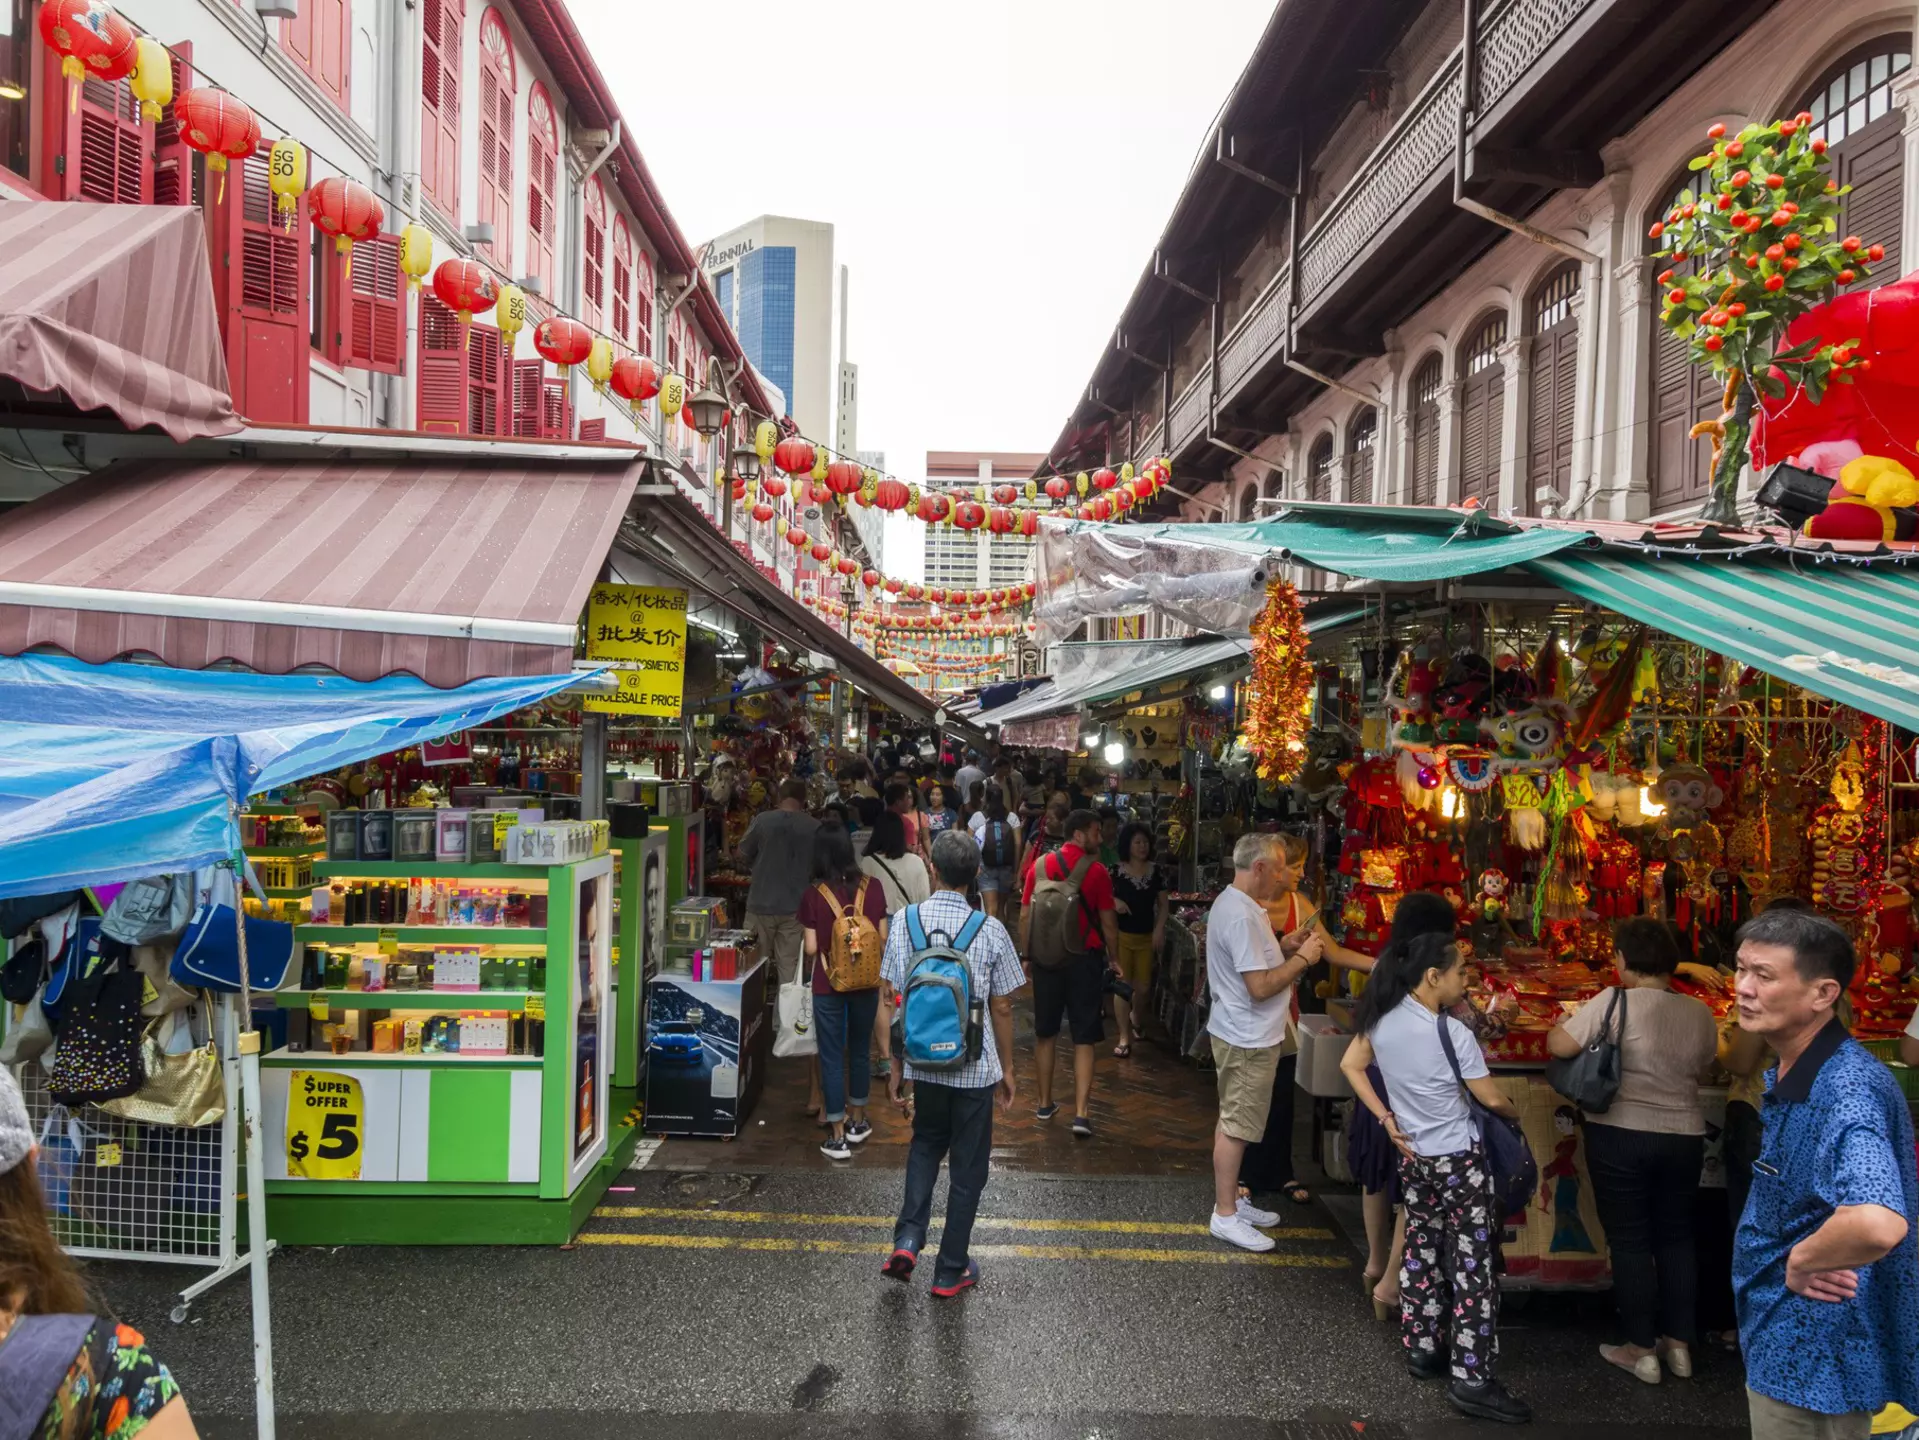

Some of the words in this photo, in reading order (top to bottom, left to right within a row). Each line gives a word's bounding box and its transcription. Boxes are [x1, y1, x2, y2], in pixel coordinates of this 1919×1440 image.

[273, 150, 294, 163] SG
[272, 163, 294, 176] 50
[696, 239, 754, 269] PERENNIAL
[510, 297, 525, 309] SG
[509, 310, 524, 321] 50
[669, 384, 682, 394] SG
[668, 394, 682, 404] 50
[592, 589, 687, 610] 香水/化妆品
[630, 611, 644, 624] @
[596, 624, 682, 647] 批发价
[626, 674, 640, 688] @
[650, 694, 681, 707] PRICE
[306, 1096, 348, 1108] OFFER
